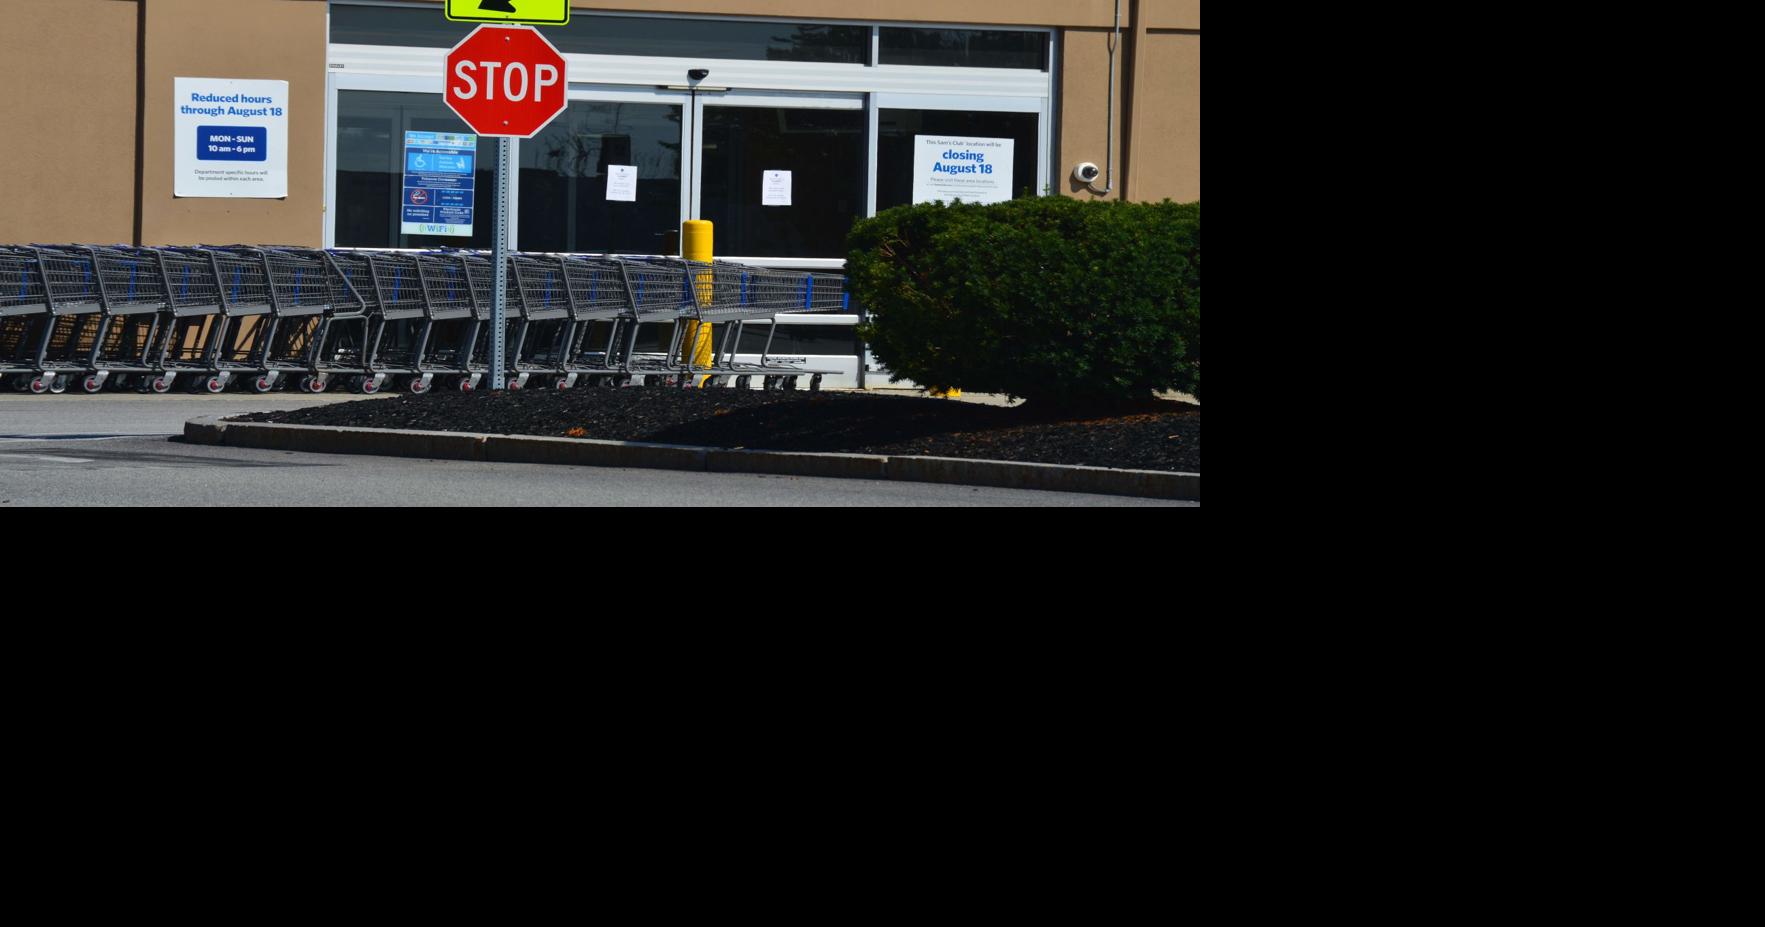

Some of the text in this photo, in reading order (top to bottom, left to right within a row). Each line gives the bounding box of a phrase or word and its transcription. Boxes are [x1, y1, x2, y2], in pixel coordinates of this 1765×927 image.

[453, 60, 559, 102] STOP
[191, 93, 273, 104] Reduced hours
[181, 105, 283, 118] through August 18
[209, 135, 231, 143] MON
[236, 145, 242, 153] 6
[942, 149, 984, 163] closing
[194, 169, 225, 177] Department
[933, 161, 993, 175] August 18
